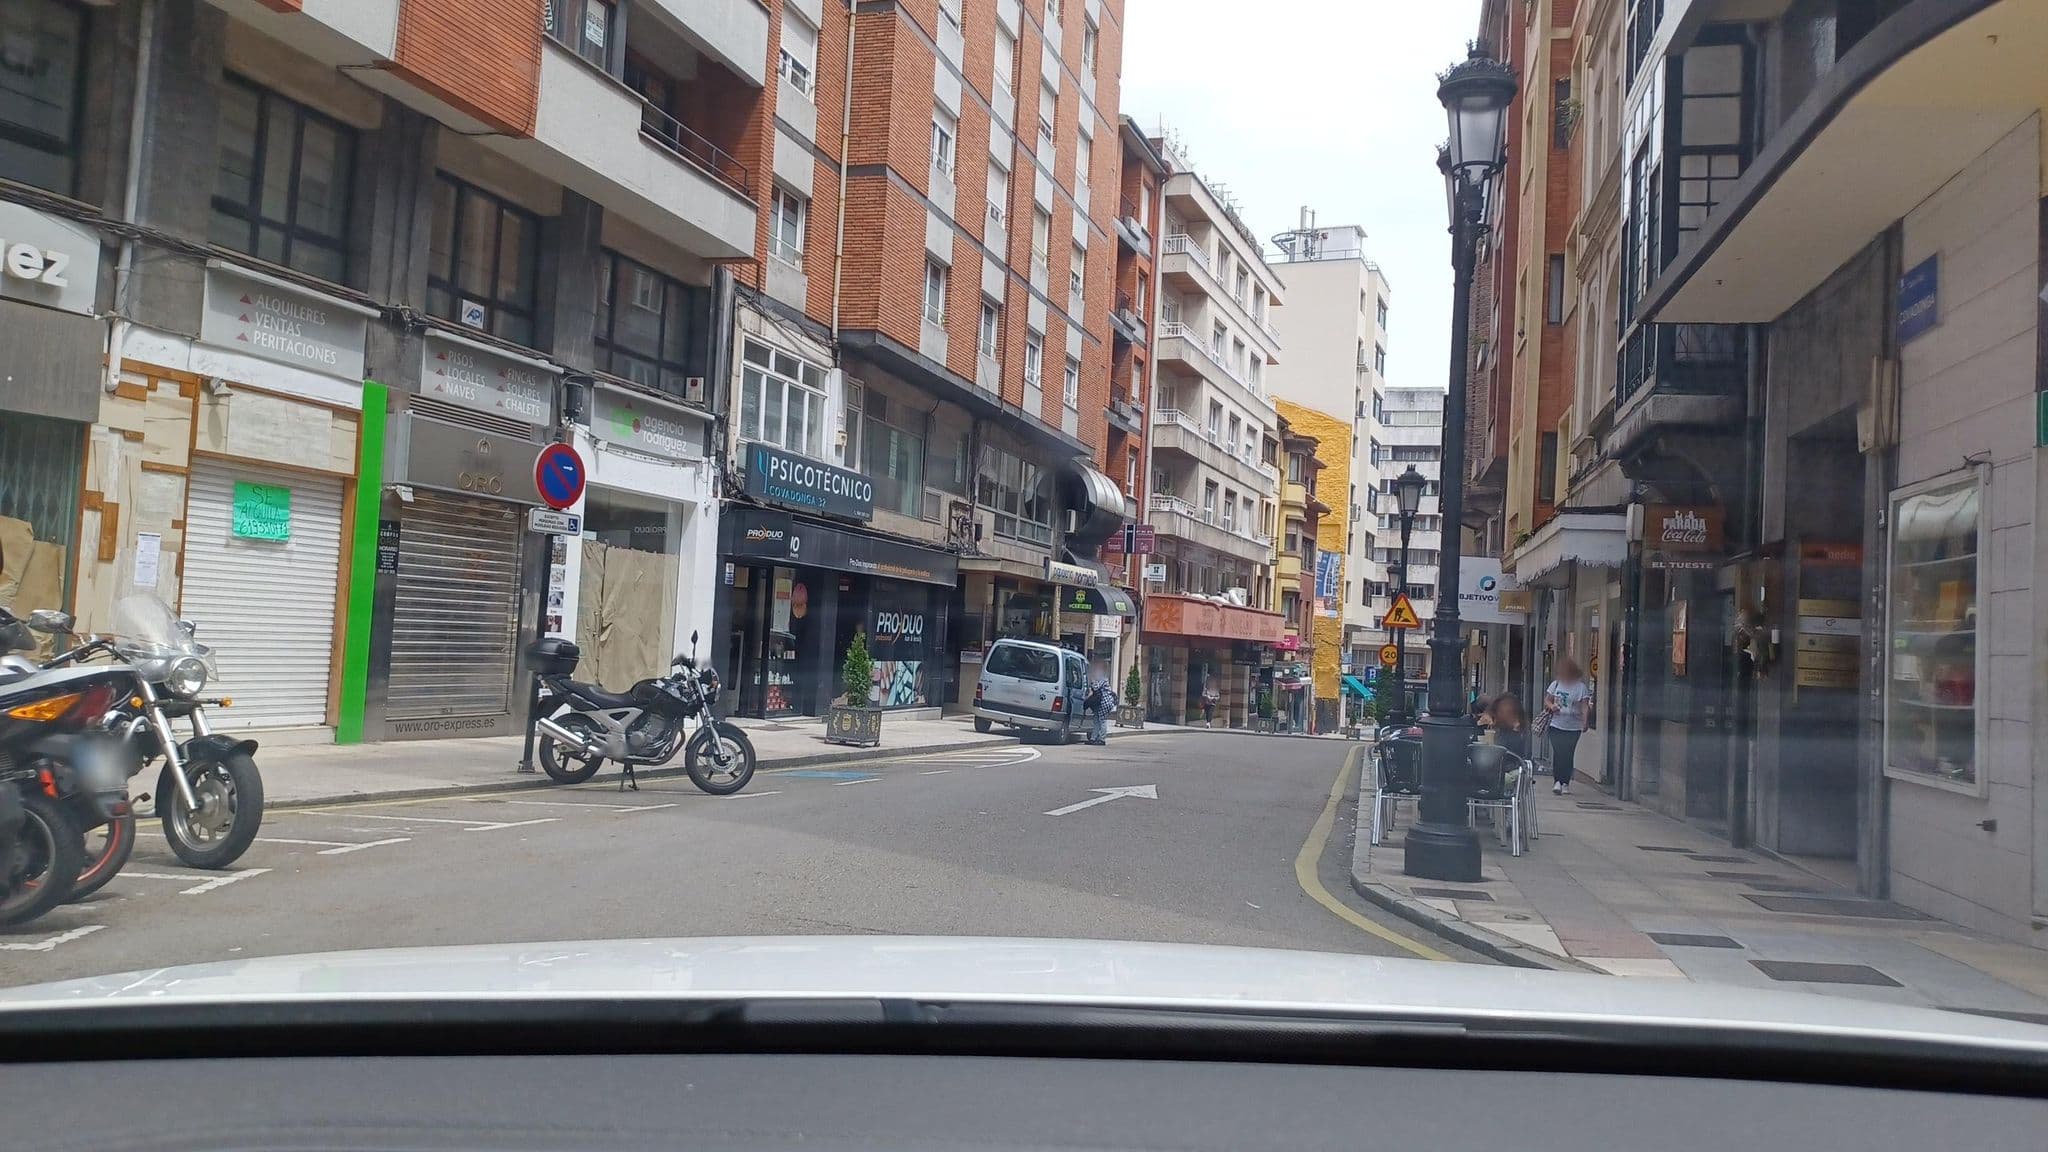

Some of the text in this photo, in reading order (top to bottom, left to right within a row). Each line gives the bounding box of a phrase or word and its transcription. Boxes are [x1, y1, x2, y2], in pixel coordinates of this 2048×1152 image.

[0, 237, 70, 288] ez
[256, 294, 327, 326] ALQUILERES
[255, 312, 302, 337] VENTAS
[253, 330, 337, 365] PERITACIONES
[447, 350, 474, 368] PISOS
[446, 365, 487, 388] LOCALES
[445, 381, 476, 401] NAVES
[506, 383, 541, 402] SOLARES
[505, 398, 541, 417] CHALETS
[643, 416, 684, 437] agencia
[458, 471, 503, 494] ORO
[770, 456, 873, 503] PSICOTÉCNICO
[251, 485, 273, 507] SE
[769, 485, 817, 504] COVADONGA
[1663, 515, 1707, 530] PARADA
[1652, 561, 1714, 569] EL TUESTE
[1459, 593, 1495, 602] BJETIVO
[1384, 650, 1398, 659] 20
[394, 718, 496, 733] www.oro-express.es
